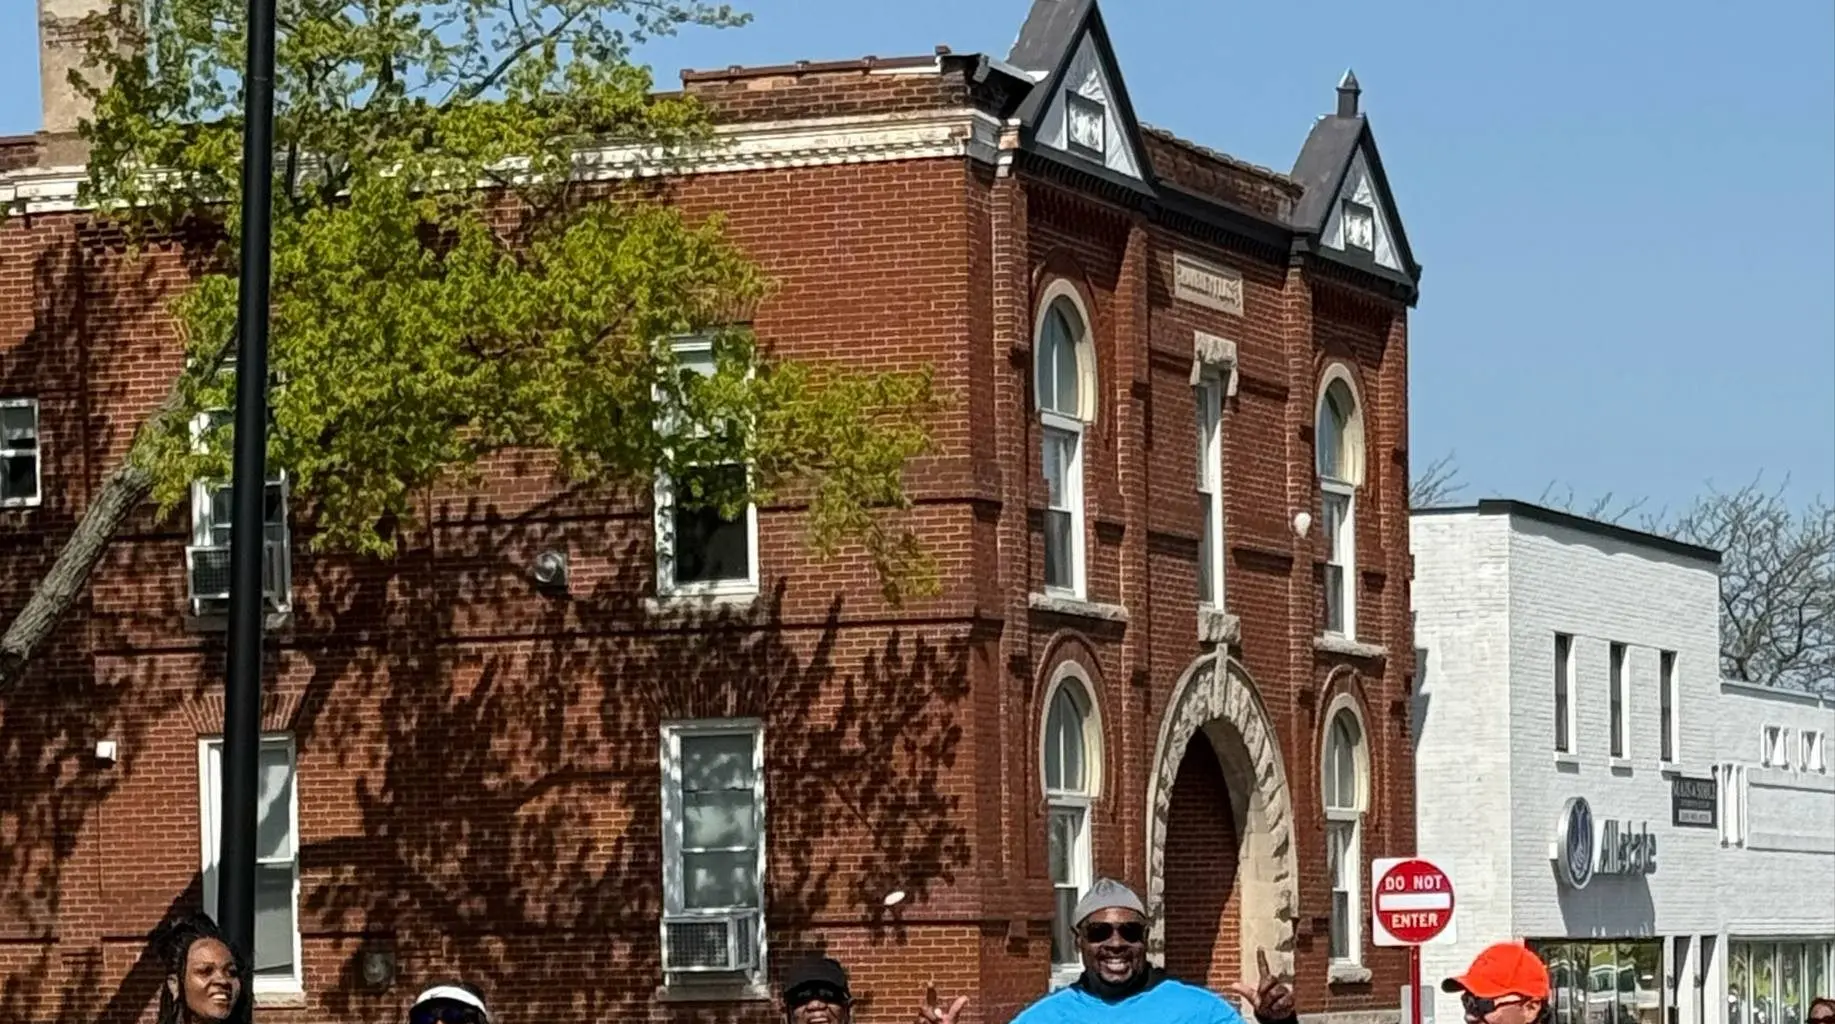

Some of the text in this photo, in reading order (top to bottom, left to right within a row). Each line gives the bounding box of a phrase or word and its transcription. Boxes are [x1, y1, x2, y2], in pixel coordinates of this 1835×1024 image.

[1595, 819, 1657, 875] Allstate
[1384, 874, 1443, 891] DO NOT
[1391, 913, 1439, 929] ENTER
